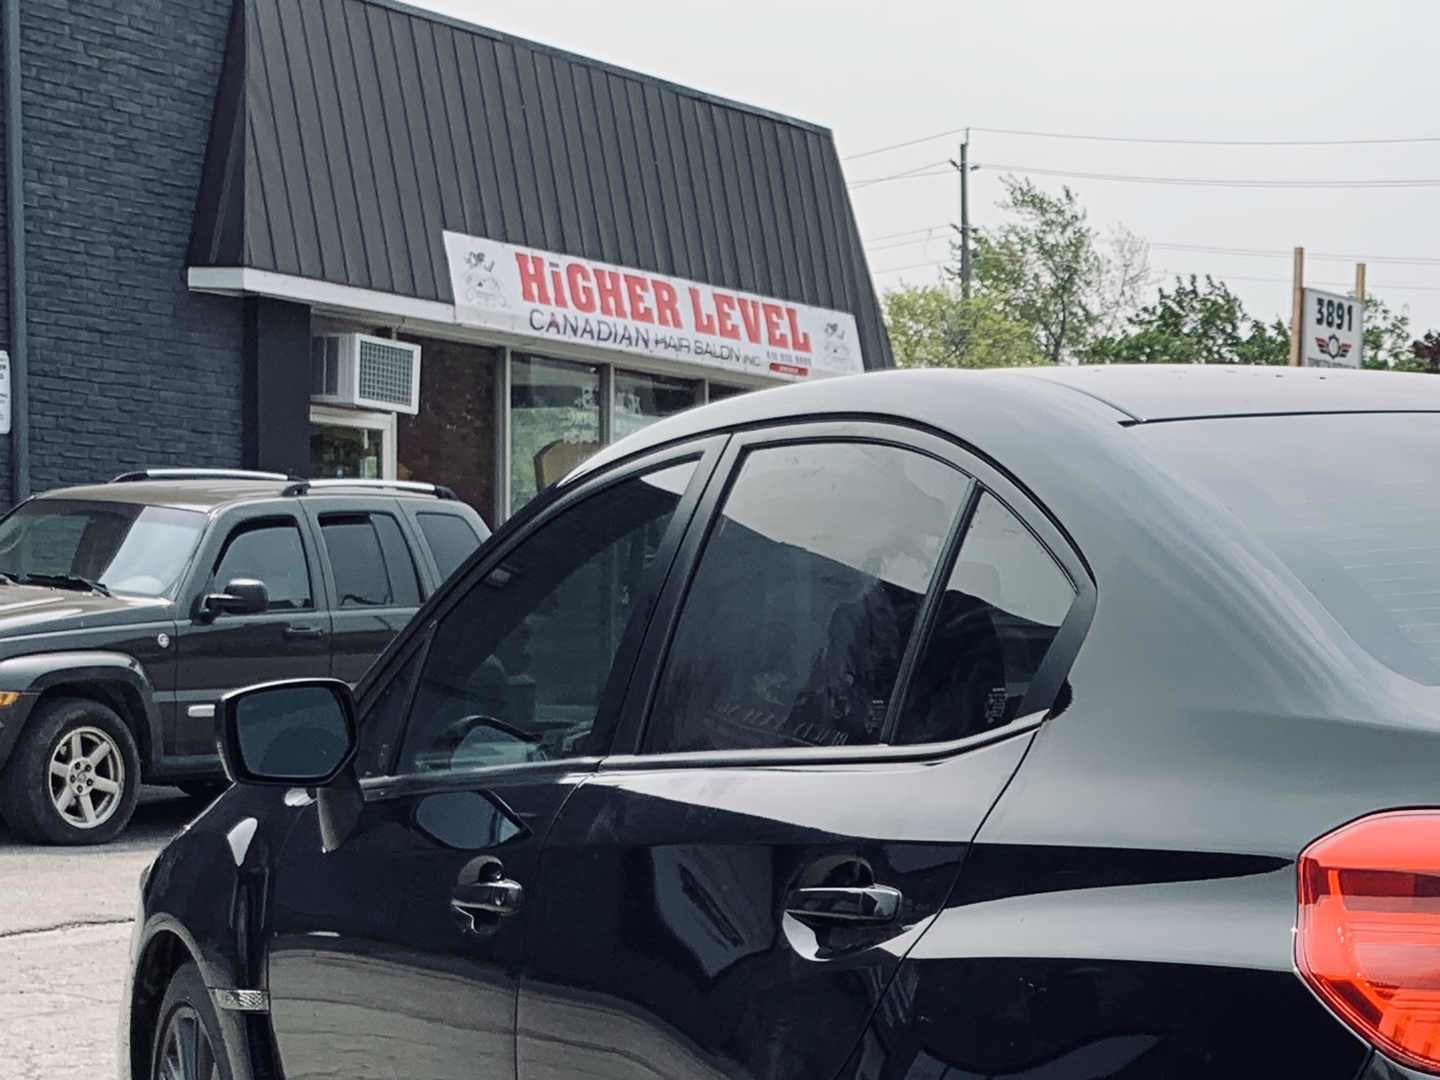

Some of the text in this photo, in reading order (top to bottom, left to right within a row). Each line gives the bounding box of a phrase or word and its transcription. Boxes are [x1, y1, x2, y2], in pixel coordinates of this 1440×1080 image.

[529, 308, 650, 349] CANADIAN
[688, 287, 812, 352] LEVEL
[1316, 297, 1353, 332] 3891
